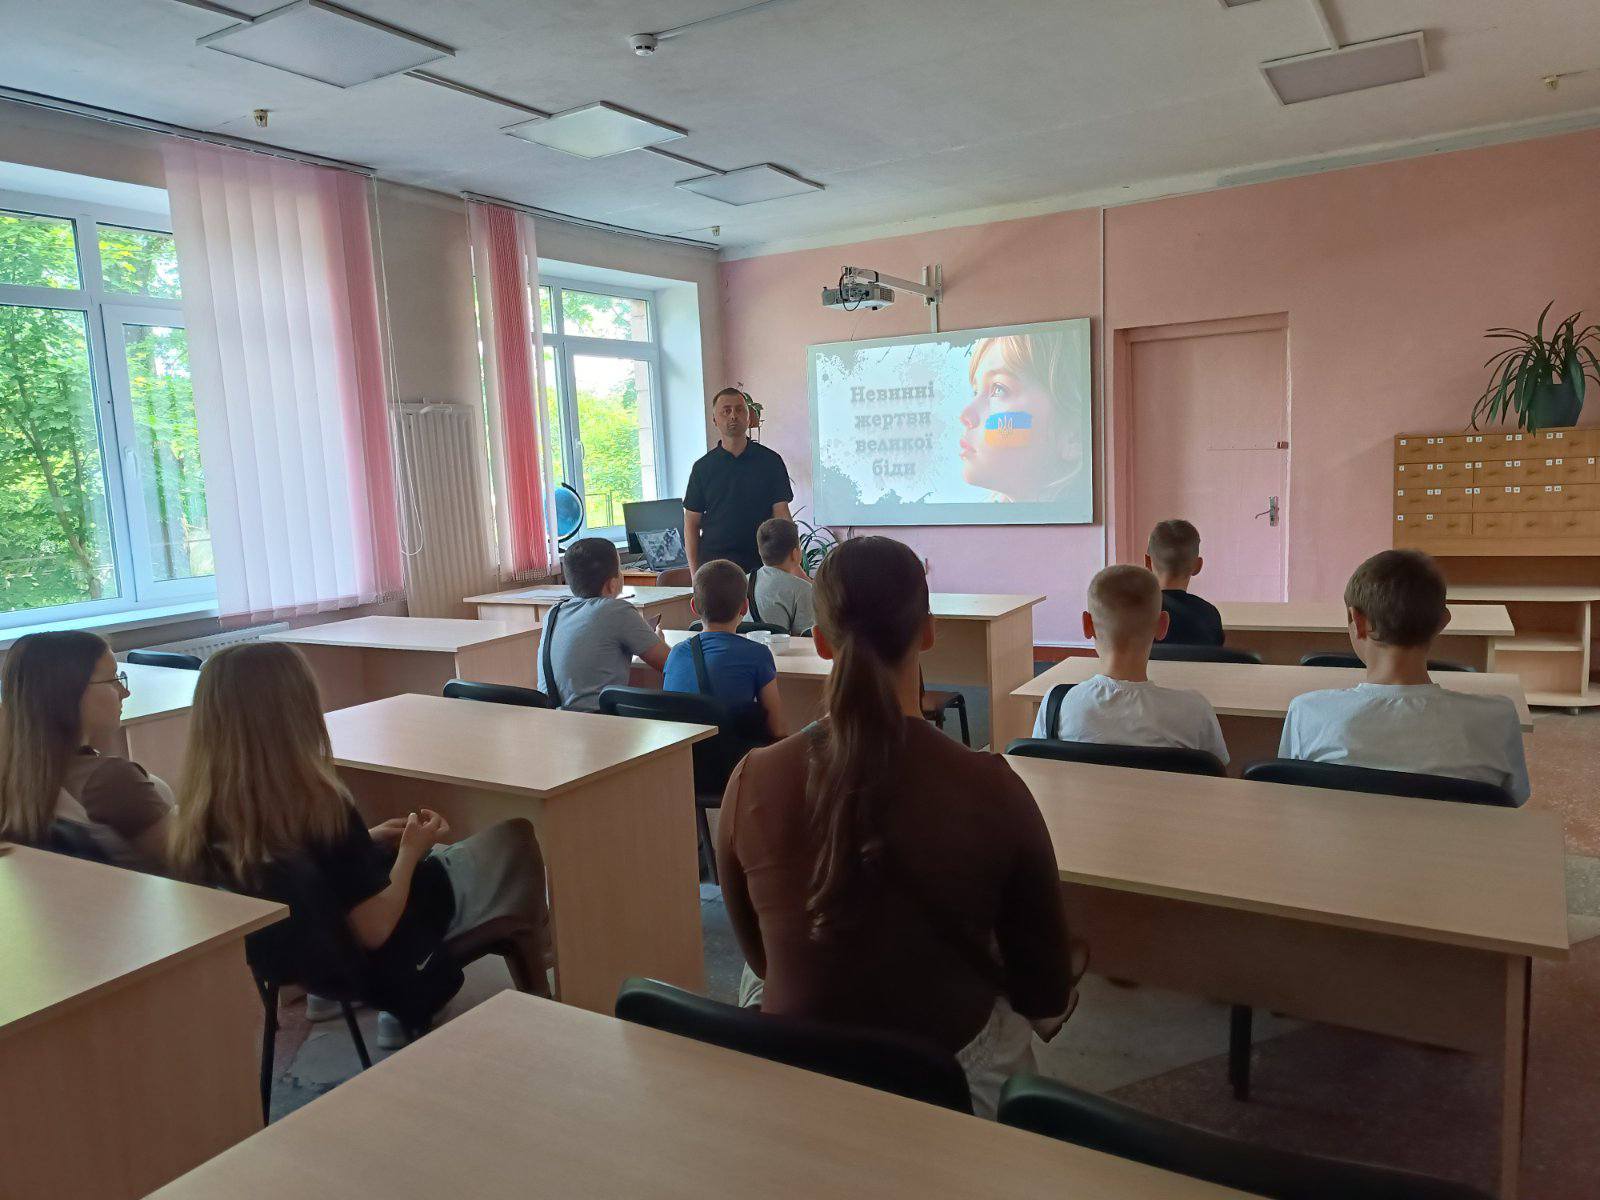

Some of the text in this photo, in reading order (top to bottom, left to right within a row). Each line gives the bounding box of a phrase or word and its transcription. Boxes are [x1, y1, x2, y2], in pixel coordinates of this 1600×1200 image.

[850, 381, 935, 403] Невинні
[854, 411, 932, 430] жертви
[855, 433, 933, 453] великої
[872, 459, 916, 477] біди
